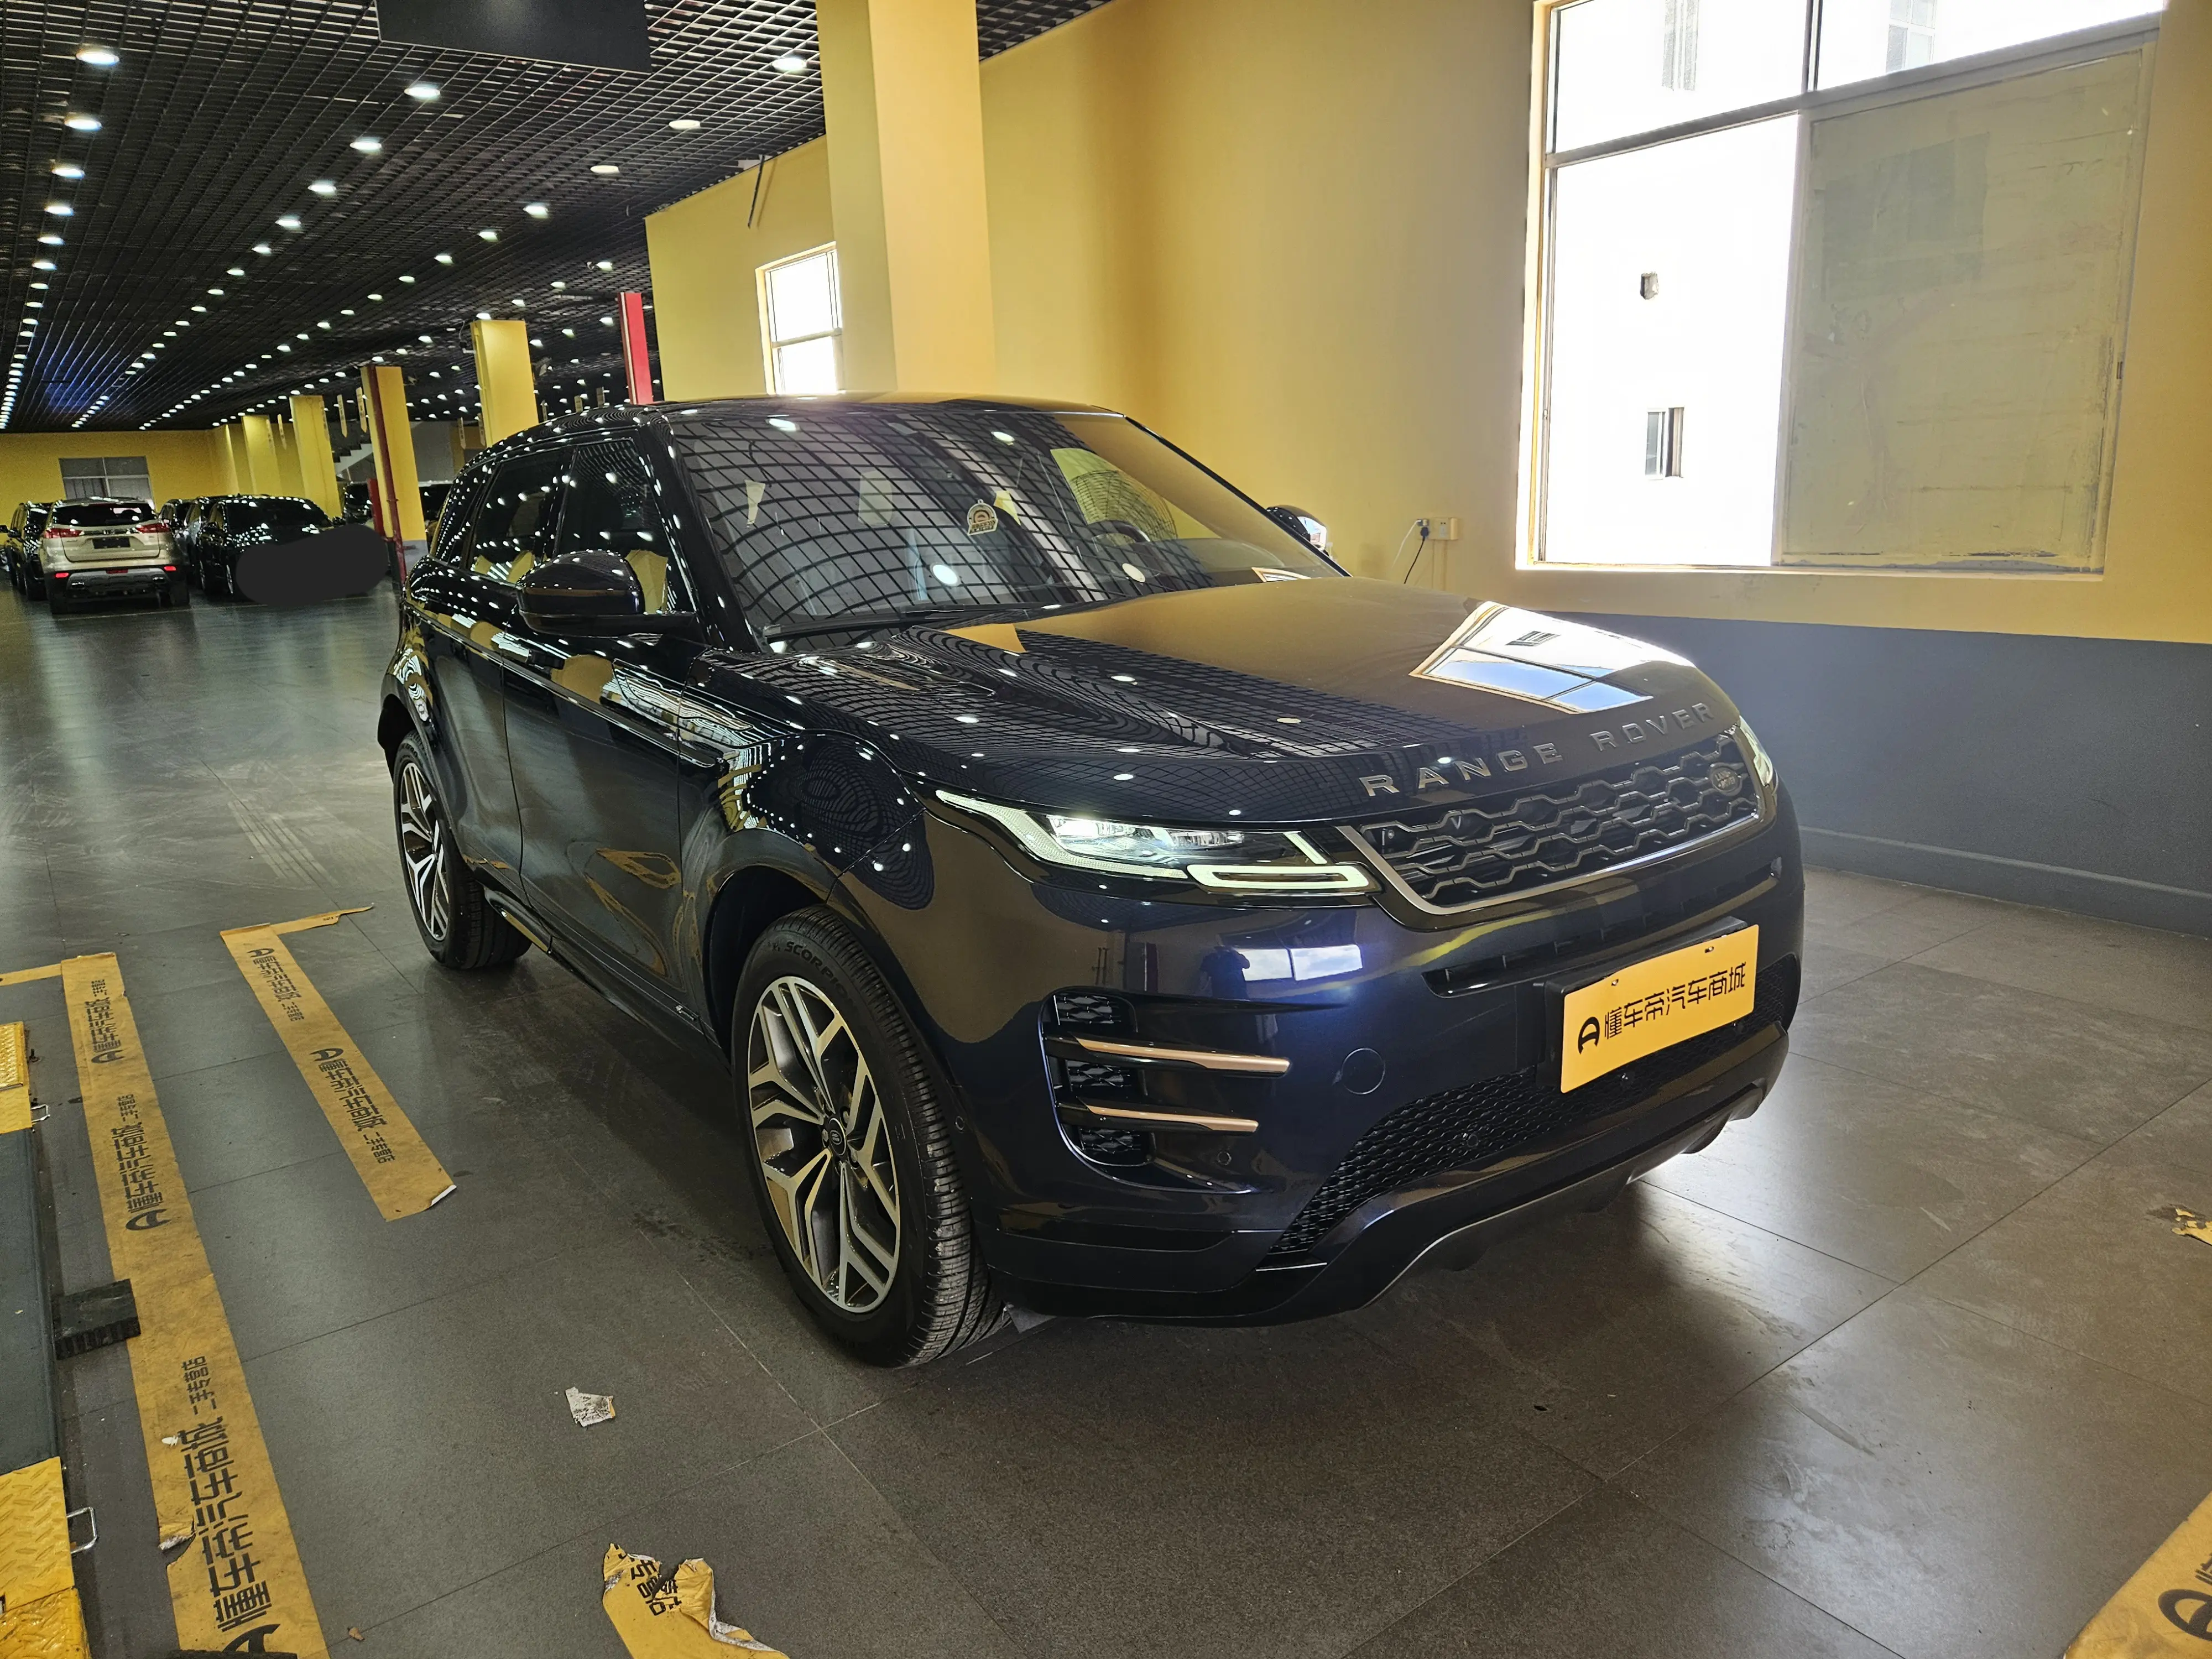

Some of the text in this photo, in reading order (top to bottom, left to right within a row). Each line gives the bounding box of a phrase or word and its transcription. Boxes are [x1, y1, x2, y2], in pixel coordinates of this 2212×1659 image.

[1358, 702, 1715, 796] RANGE ROVER
[1604, 962, 1746, 1040] 懂车帝汽车商城
[319, 1058, 388, 1131] 懂车帝汽车商城
[110, 1121, 164, 1213] 懂车帝汽车商城
[178, 1355, 272, 1632] 懂车帝汽车商城 二手专营店
